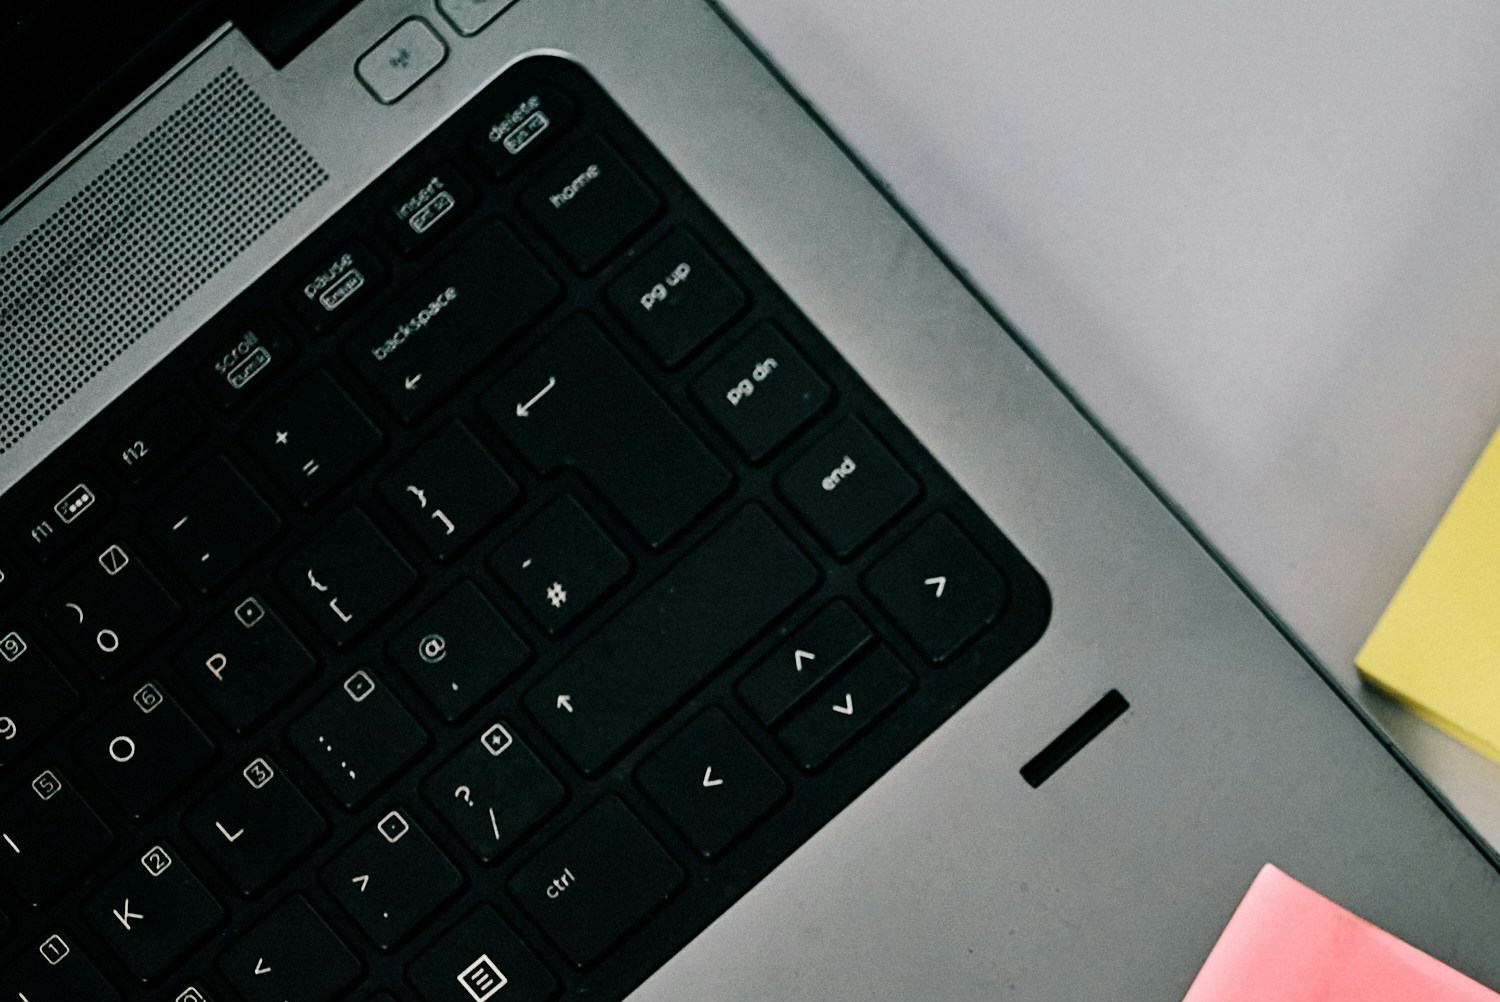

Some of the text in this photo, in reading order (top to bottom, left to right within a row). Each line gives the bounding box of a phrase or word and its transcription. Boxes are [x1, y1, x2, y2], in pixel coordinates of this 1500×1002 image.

[550, 165, 598, 207] home
[304, 252, 353, 301] pause
[639, 261, 692, 312] pg up
[371, 286, 459, 362] backspace
[215, 330, 258, 375] scroll
[726, 355, 779, 408] pg dn
[121, 440, 149, 466] f12
[822, 457, 855, 490] end
[31, 521, 54, 543] f11
[547, 583, 566, 607] #
[419, 635, 445, 662] @
[206, 653, 226, 680] P
[455, 786, 473, 806] ?
[216, 822, 243, 842] L
[546, 868, 576, 899] ctrl
[113, 899, 143, 930] K
